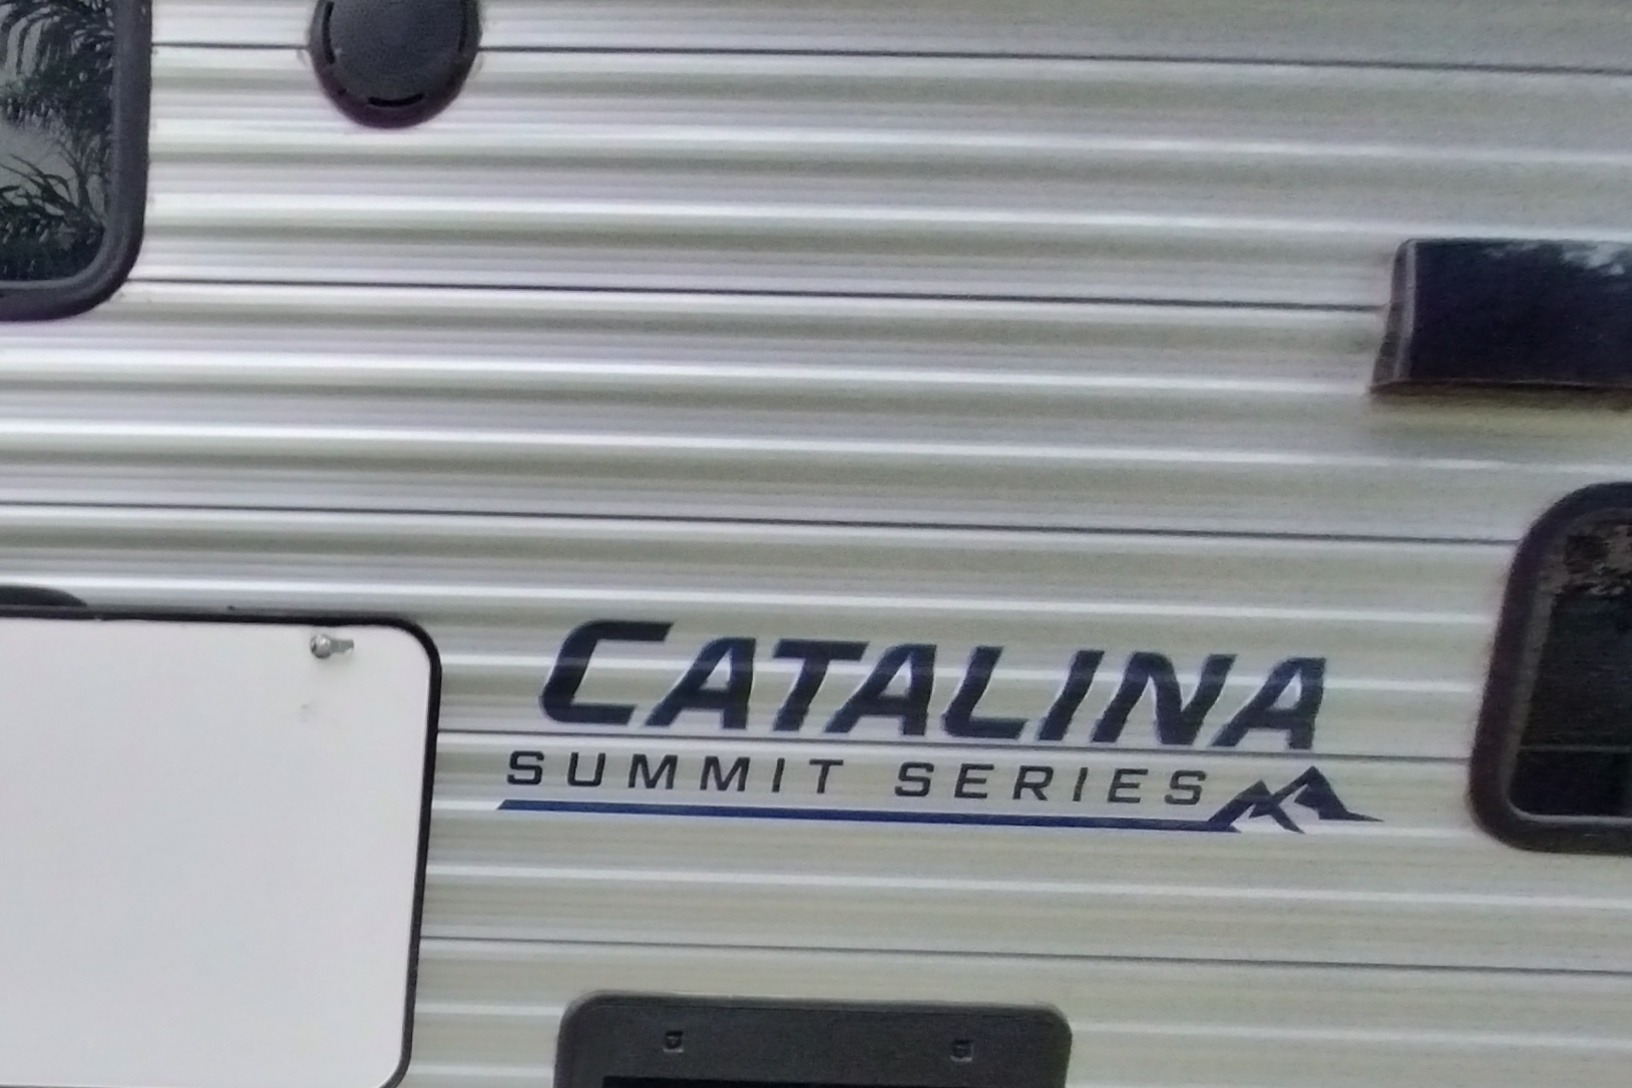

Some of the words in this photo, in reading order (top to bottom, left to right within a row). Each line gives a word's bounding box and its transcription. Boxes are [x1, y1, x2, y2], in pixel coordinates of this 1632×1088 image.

[539, 620, 1327, 750] CATALINA
[506, 750, 844, 794] SUMMIT
[894, 761, 1208, 806] SERIES
